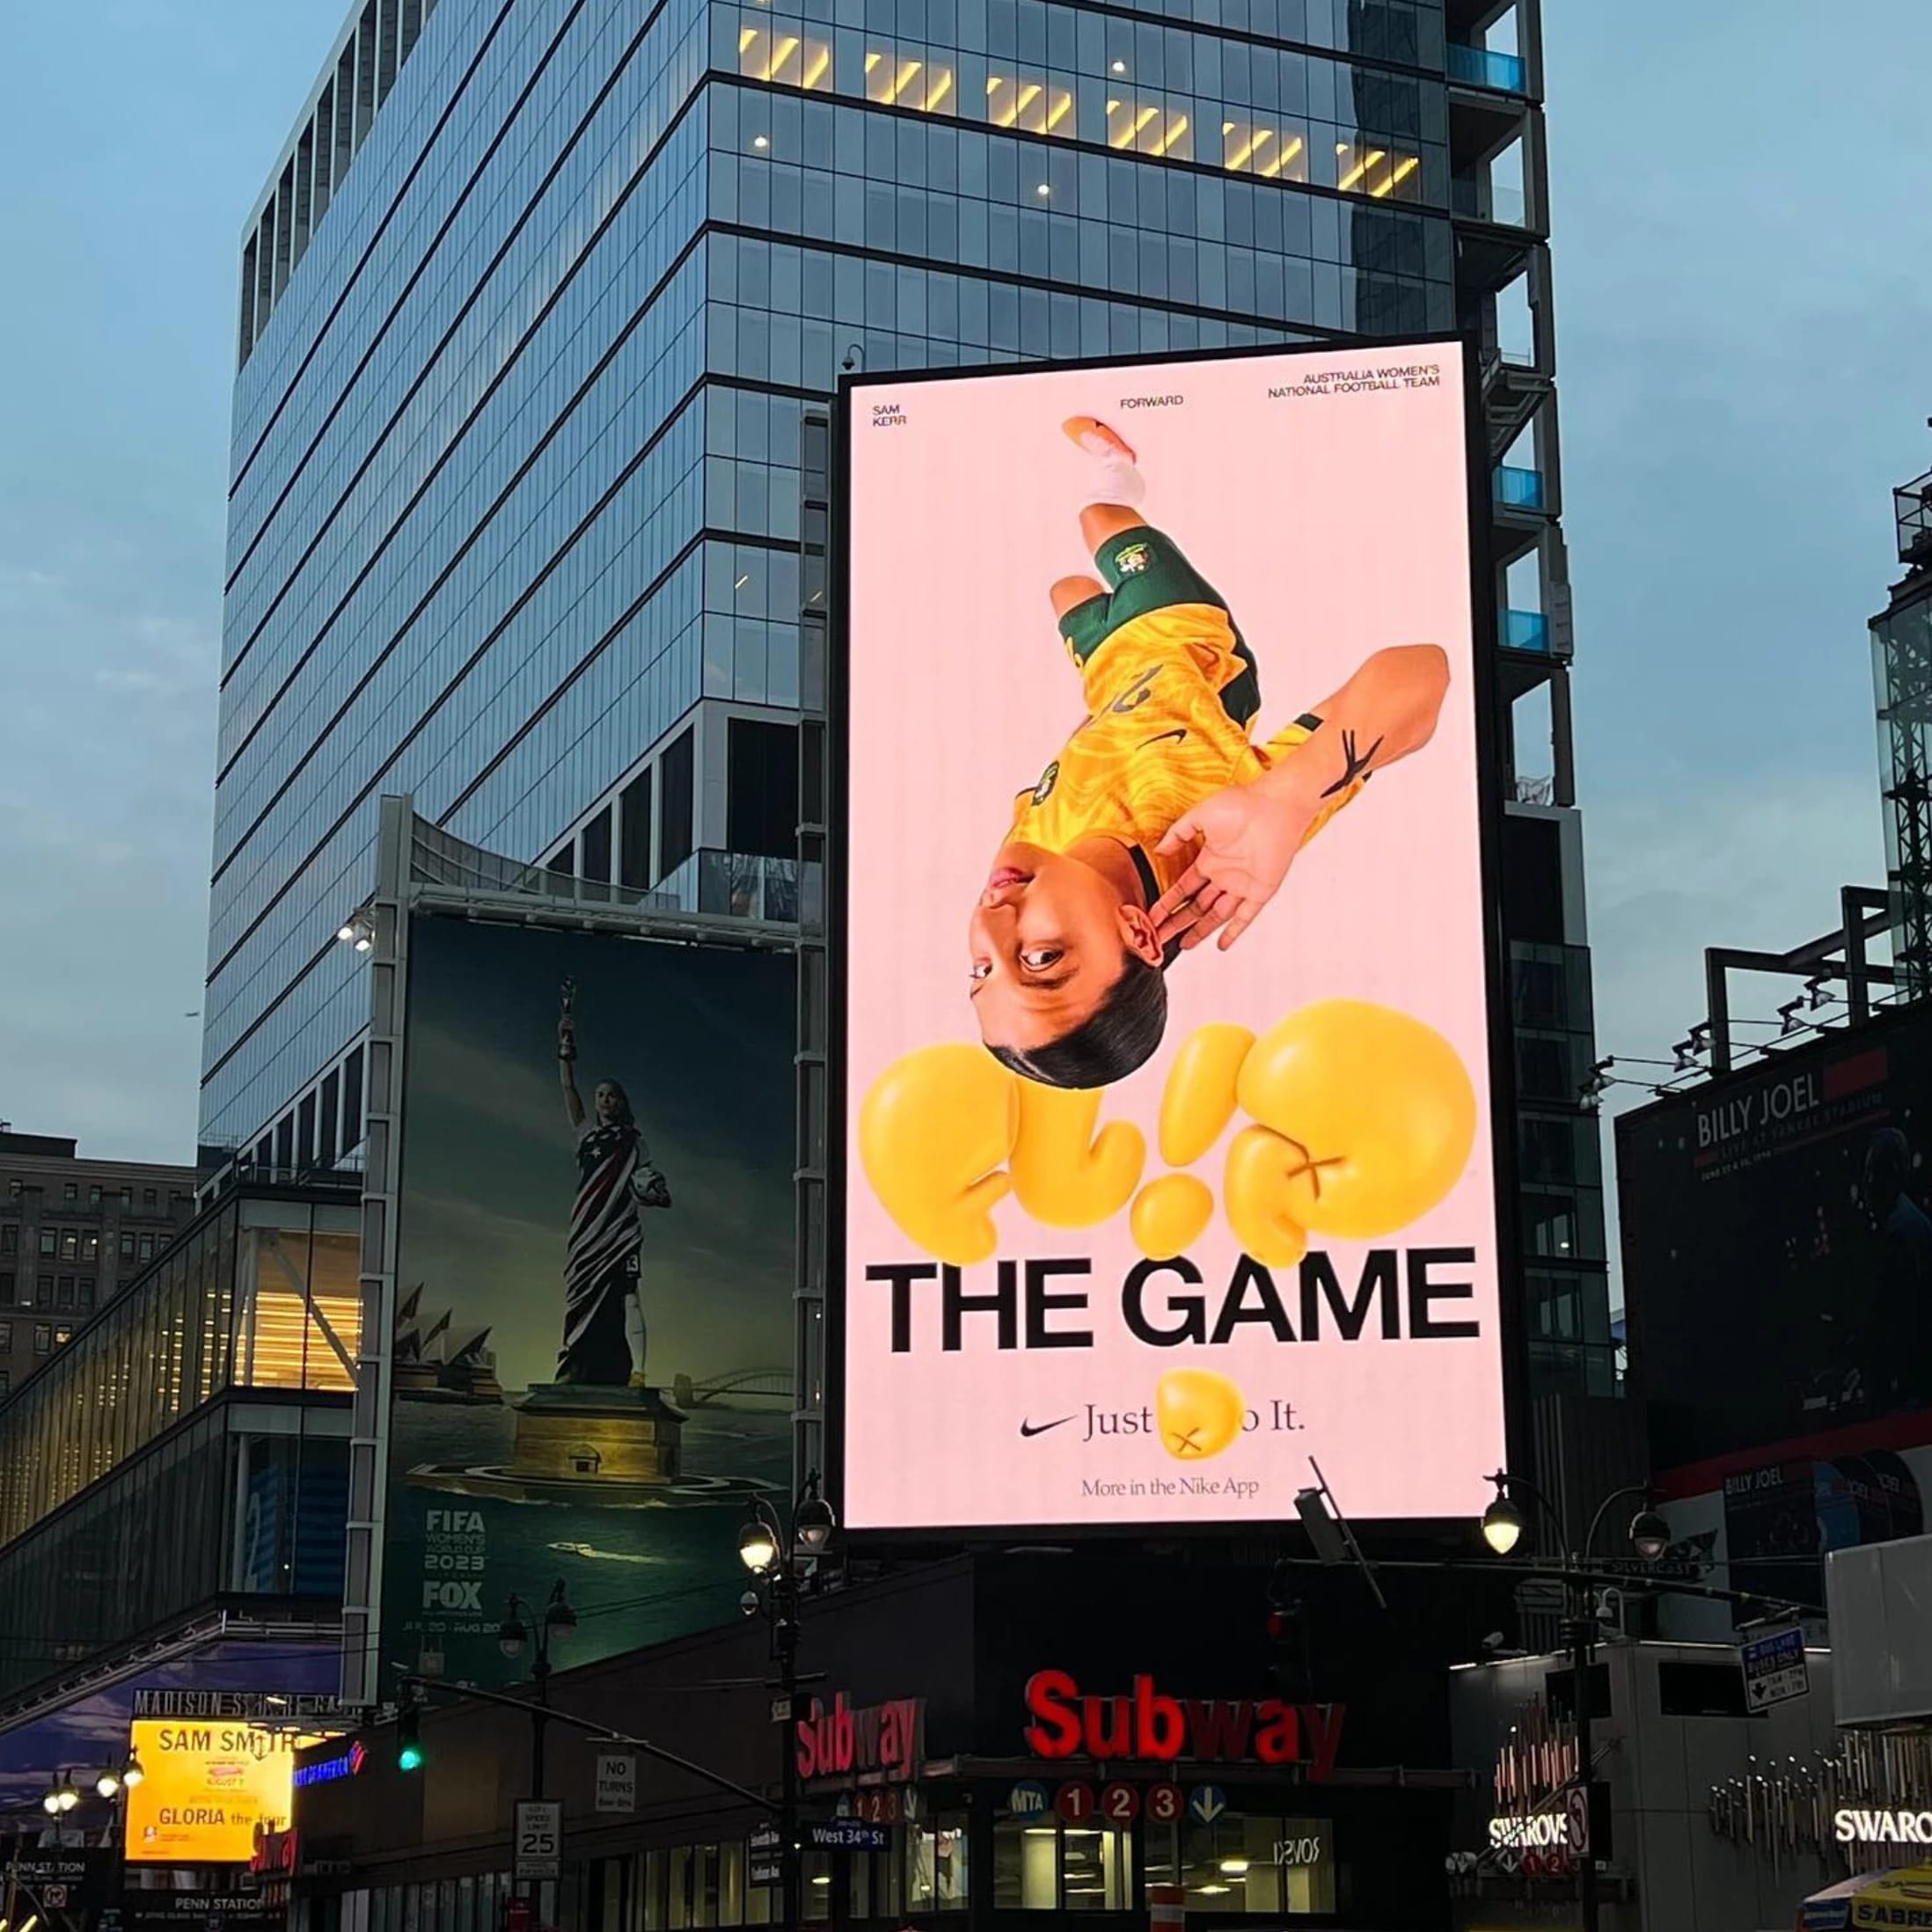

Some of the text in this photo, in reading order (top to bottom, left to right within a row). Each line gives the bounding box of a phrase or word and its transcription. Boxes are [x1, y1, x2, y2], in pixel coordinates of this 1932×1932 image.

[1303, 364, 1440, 384] AUSTRALIA WOMEN'S
[1268, 376, 1440, 399] NATIONAL FOOTBALL TEAM
[873, 404, 900, 415] SAM
[1120, 395, 1183, 409] FORWARD
[873, 414, 907, 427] KERR
[1697, 1072, 1820, 1147] BILLY JOEL
[866, 1247, 1481, 1353] THE GAME
[1083, 1404, 1154, 1442] Just
[1270, 1400, 1306, 1431] It.
[1082, 1478, 1259, 1499] More in the Nike App
[1725, 1466, 1784, 1495] BILLY JOEL
[426, 1509, 486, 1533] FIFA
[425, 1533, 486, 1545] WOMEN'S
[424, 1555, 485, 1571] 2023
[422, 1581, 483, 1610] FOX
[135, 1690, 221, 1716] MADISON
[794, 1689, 918, 1780] Subway
[1023, 1668, 1345, 1783] Subway
[158, 1730, 211, 1751] SAM
[606, 1761, 626, 1775] NO
[599, 1780, 633, 1792] TURNS
[872, 1795, 881, 1822] 2
[1011, 1788, 1175, 1817] MTA 1 2 3
[158, 1808, 225, 1825] GLORIA
[231, 1813, 252, 1825] the
[523, 1833, 554, 1853] 25
[812, 1828, 885, 1845] West 34th St
[175, 1897, 210, 1910] PENN
